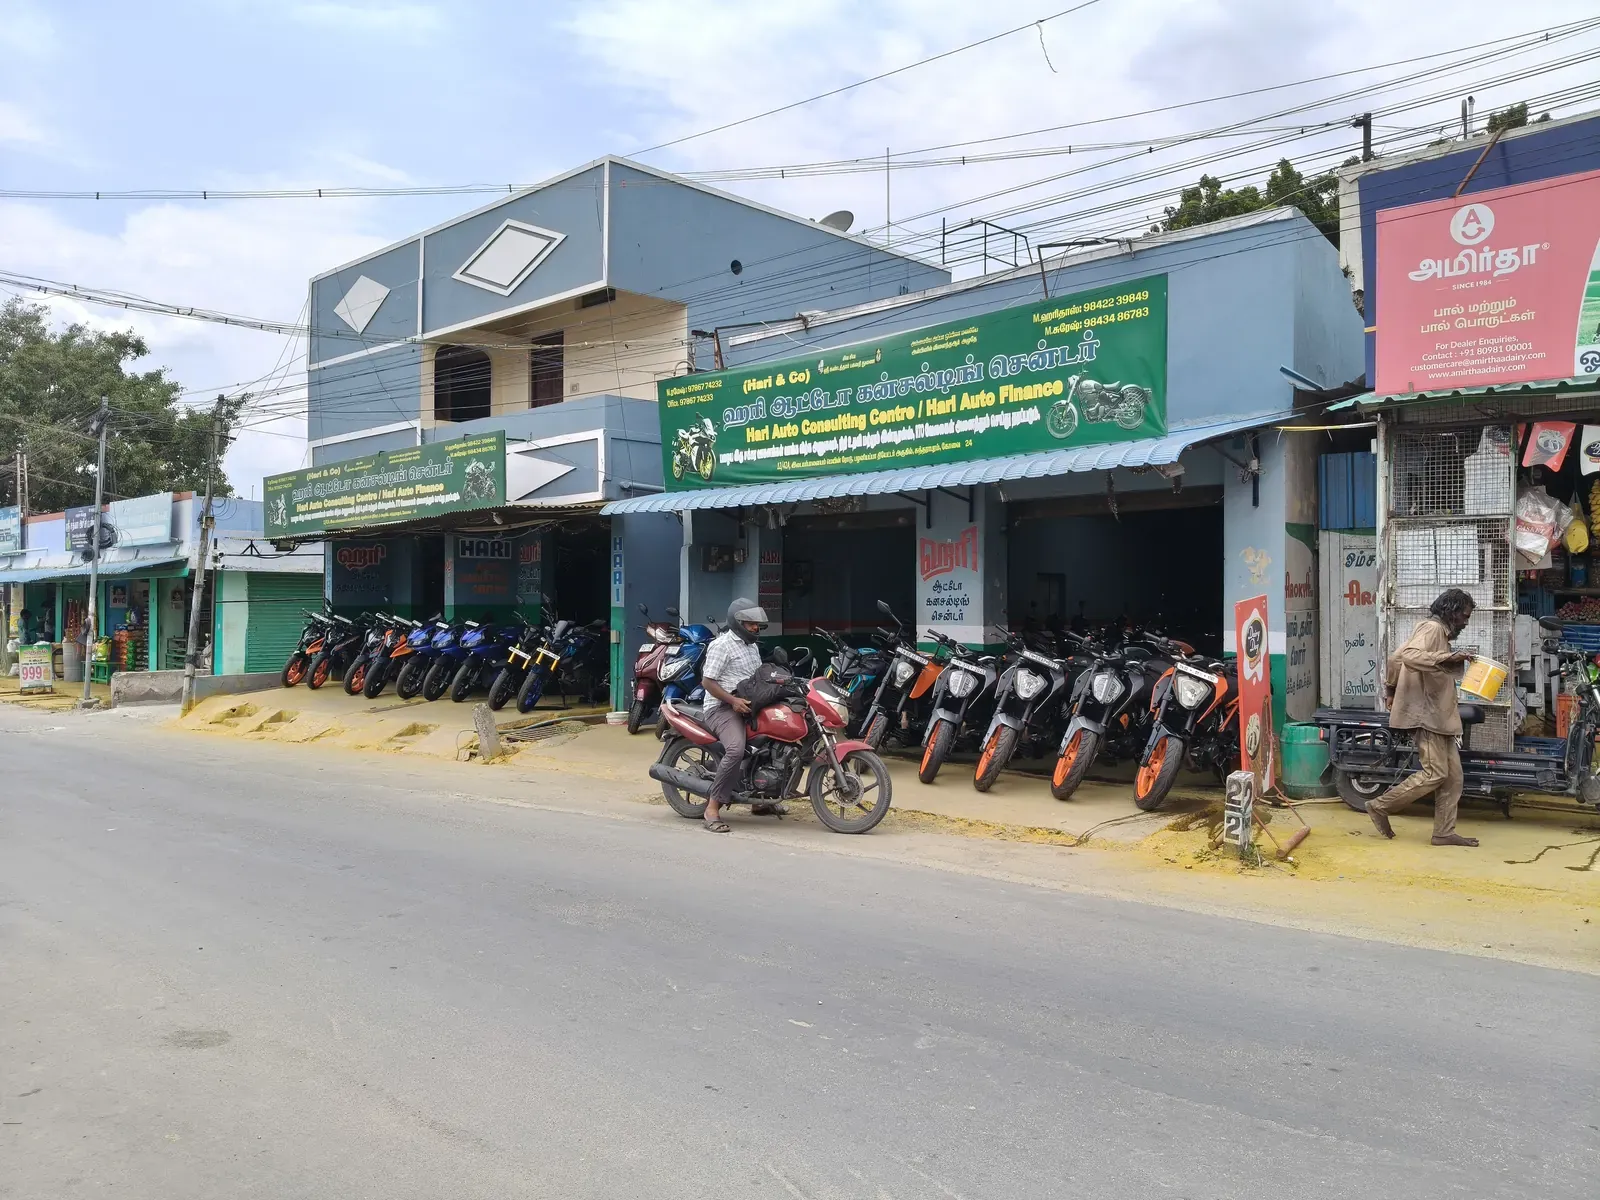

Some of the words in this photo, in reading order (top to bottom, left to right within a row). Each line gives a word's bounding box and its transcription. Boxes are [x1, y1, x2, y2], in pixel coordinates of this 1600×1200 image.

[1408, 243, 1540, 282] அமிர்தா
[1452, 281, 1475, 291] SINCE
[1475, 279, 1492, 288] 1984
[1083, 297, 1115, 313] 98422
[1116, 290, 1149, 306] 39849
[1433, 303, 1465, 318] பால்
[1468, 296, 1517, 315] மற்றும்
[1083, 313, 1116, 329] 98434
[1116, 306, 1149, 322] 86783
[1420, 319, 1451, 334] பால்
[1454, 309, 1536, 329] பொருட்கள்
[1422, 351, 1453, 362] Contact
[1459, 348, 1475, 358] +91
[1476, 345, 1504, 356] 80981
[1505, 341, 1533, 352] 00001
[1435, 342, 1449, 351] For
[1450, 339, 1477, 349] Dealer
[1478, 335, 1519, 347] Enquiries,
[1410, 351, 1547, 372] customercare@amirthaadairy.com
[1428, 364, 1526, 380] www.amirthaadairy.com
[722, 395, 768, 432] ஹரி
[770, 386, 853, 419] ஆட்டோ
[855, 353, 985, 404] கன்சல்டிங்
[988, 329, 1101, 380] சென்டர்
[742, 375, 772, 395] (Hari
[775, 373, 786, 387] &
[788, 369, 811, 385] Co)
[745, 424, 770, 443] Hari
[771, 421, 800, 440] Auto
[800, 411, 867, 436] Consulting
[917, 399, 924, 419] /
[925, 394, 957, 417] Hari
[959, 390, 996, 412] Auto
[998, 379, 1064, 405] Finance
[964, 438, 973, 448] 24
[291, 482, 314, 505] ஹரி
[313, 477, 352, 498] ஆட்டோ
[352, 464, 408, 490] கன்சல்டிங்
[408, 456, 454, 480] சென்டர்
[322, 469, 329, 478] &
[329, 466, 341, 477] Co)
[308, 499, 323, 511] Auto
[397, 485, 414, 496] Auto
[415, 482, 445, 495] Finance
[459, 539, 512, 559] HARI
[919, 525, 978, 582] ஹரி
[613, 536, 623, 603] HARI
[931, 608, 964, 622] சென்டர்
[22, 665, 43, 681] 999
[1225, 816, 1241, 841] 2
